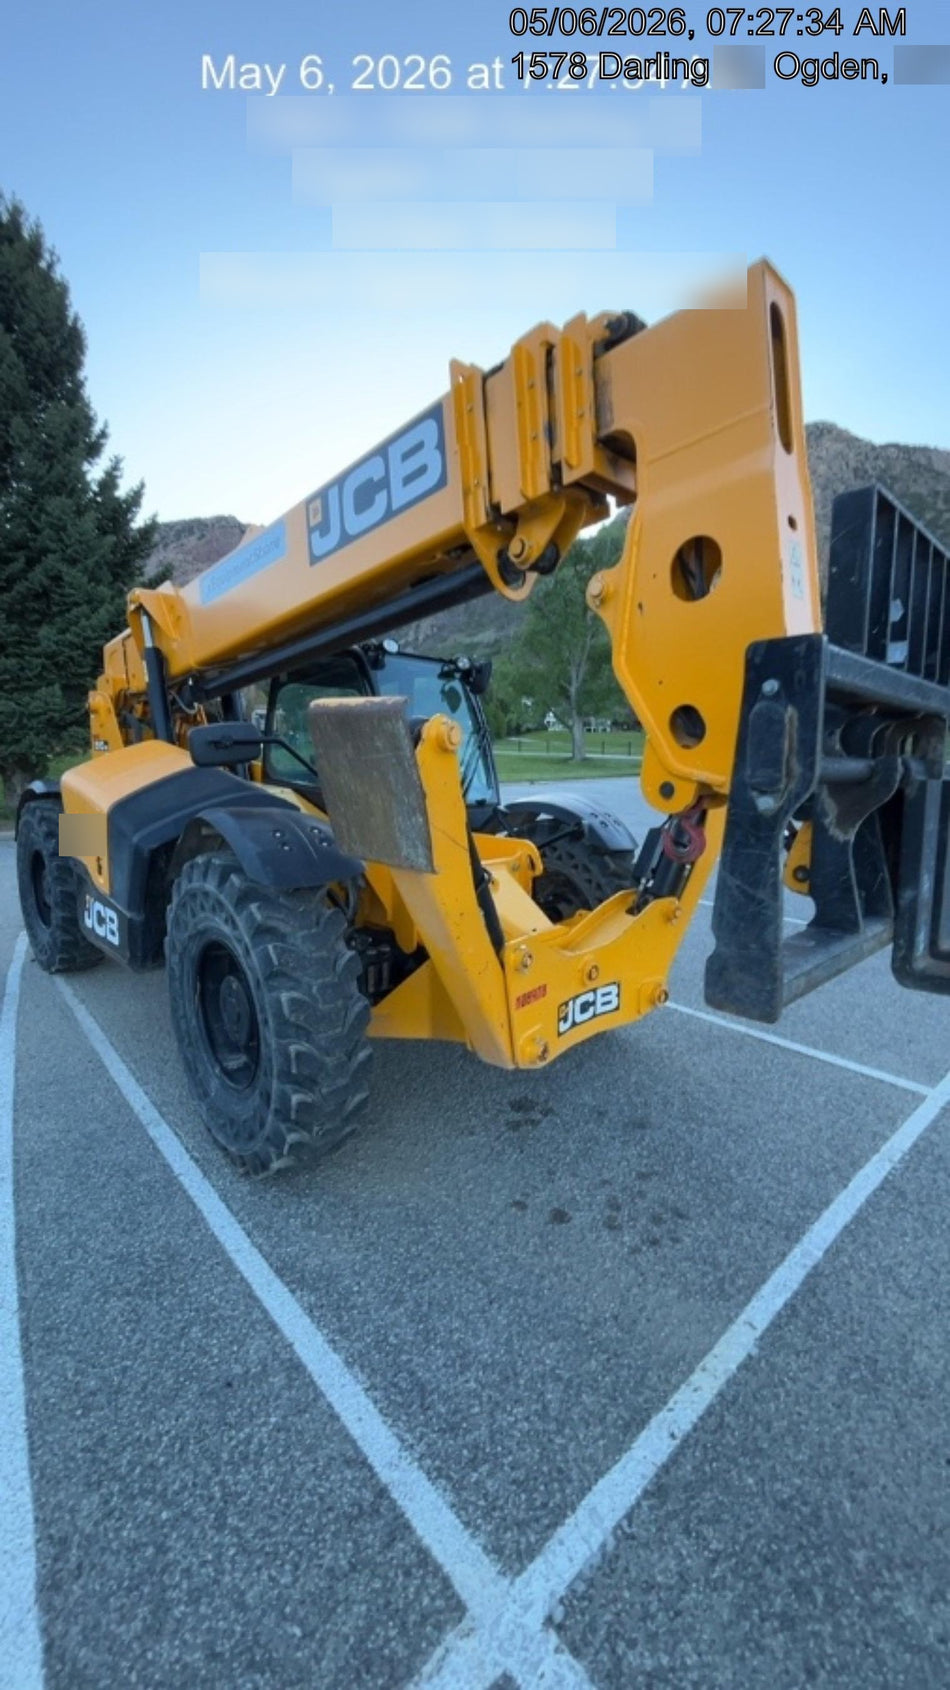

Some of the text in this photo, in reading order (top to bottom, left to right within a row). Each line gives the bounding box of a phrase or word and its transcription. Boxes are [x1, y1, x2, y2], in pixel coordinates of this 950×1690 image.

[310, 417, 443, 558] JCB
[84, 896, 120, 946] JCB
[558, 983, 620, 1034] JCB
